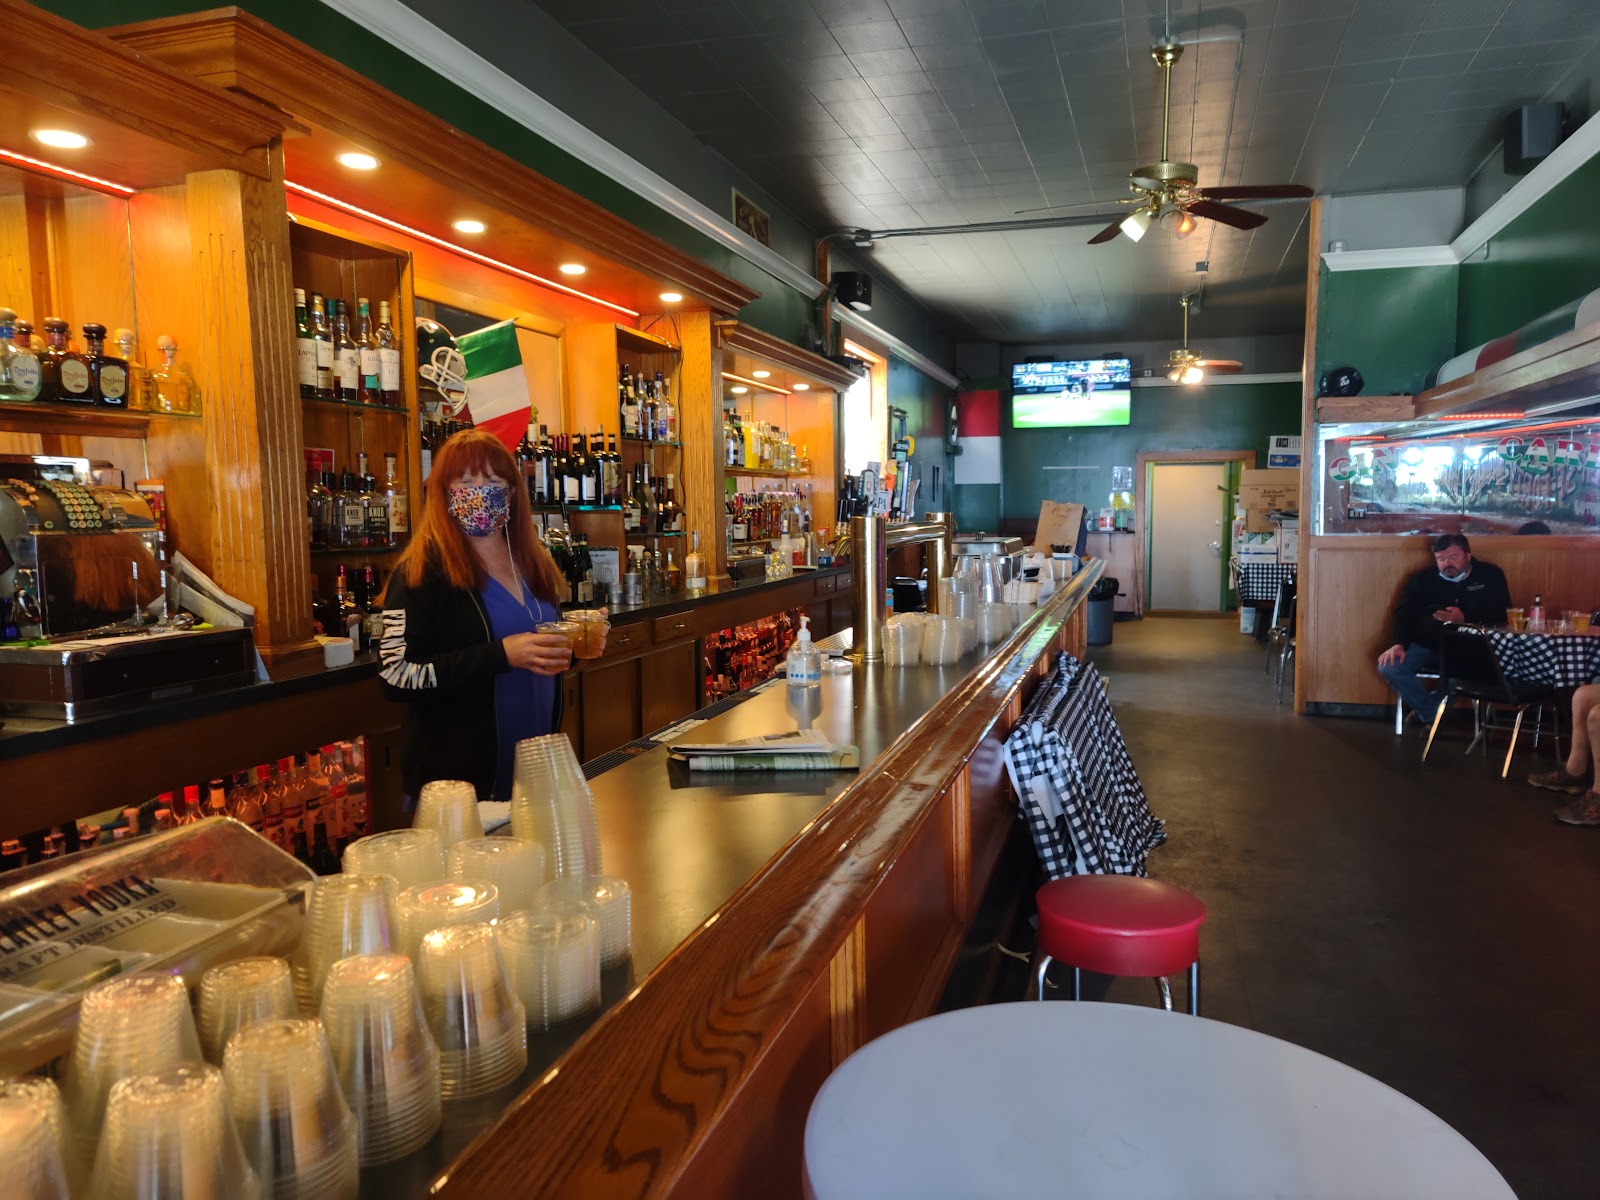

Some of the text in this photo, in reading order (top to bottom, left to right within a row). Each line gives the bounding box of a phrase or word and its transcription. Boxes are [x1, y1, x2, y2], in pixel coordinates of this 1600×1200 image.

[368, 506, 385, 518] KNOB
[71, 875, 160, 917] VODKA
[65, 898, 177, 950] DISTILLED
